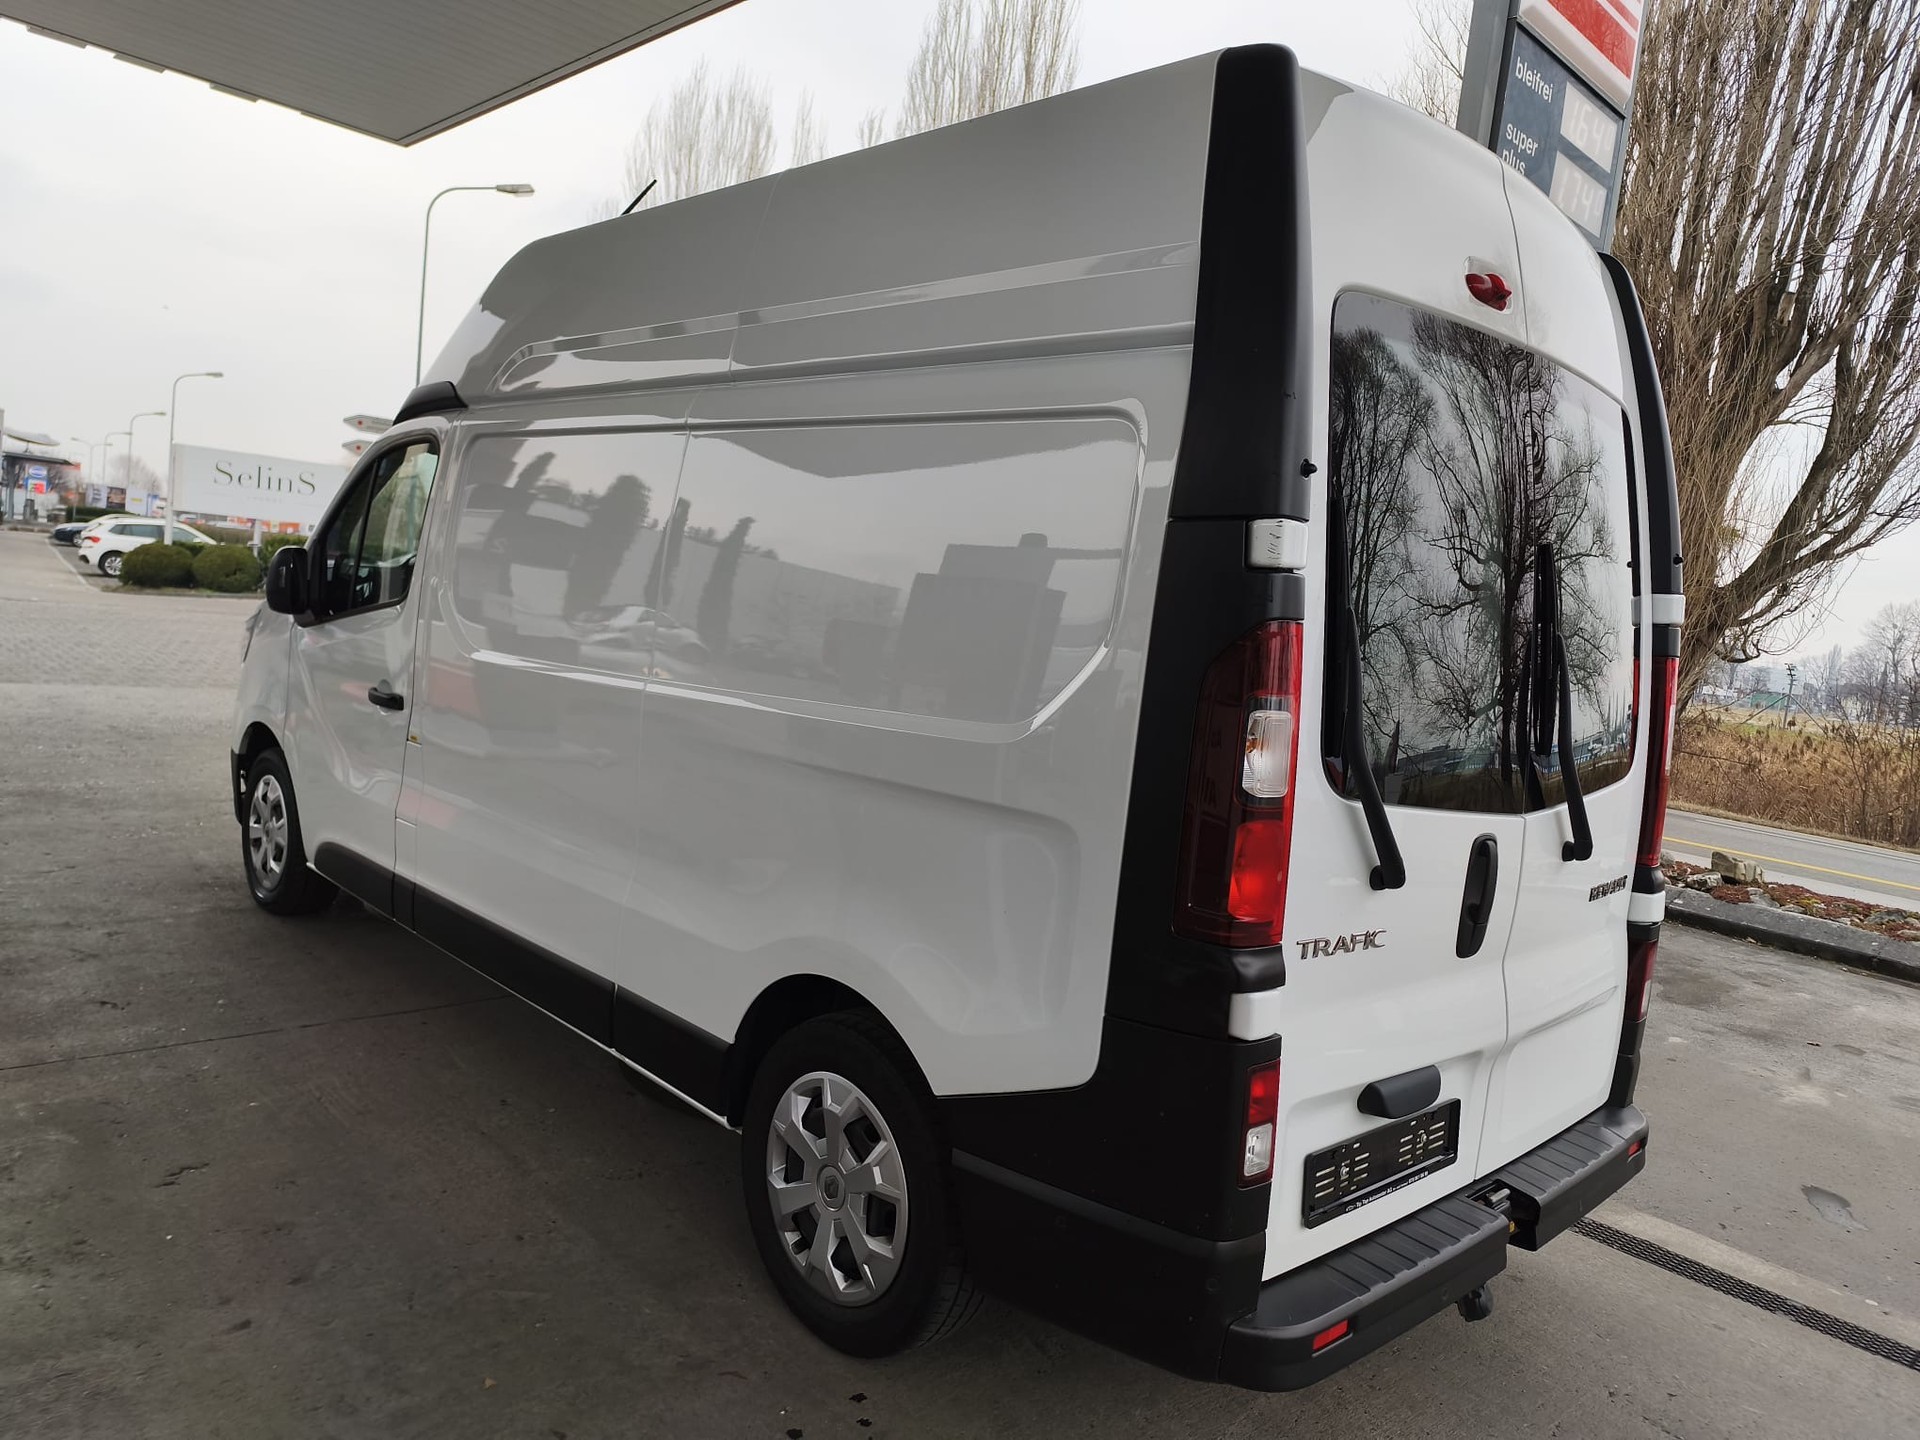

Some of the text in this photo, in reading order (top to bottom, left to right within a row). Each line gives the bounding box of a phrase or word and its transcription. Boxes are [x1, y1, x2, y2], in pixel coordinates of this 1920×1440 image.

[1514, 56, 1553, 103] bleifrei
[1505, 122, 1538, 157] super
[213, 459, 316, 496] SelinS
[1296, 929, 1387, 960] TRAFIC
